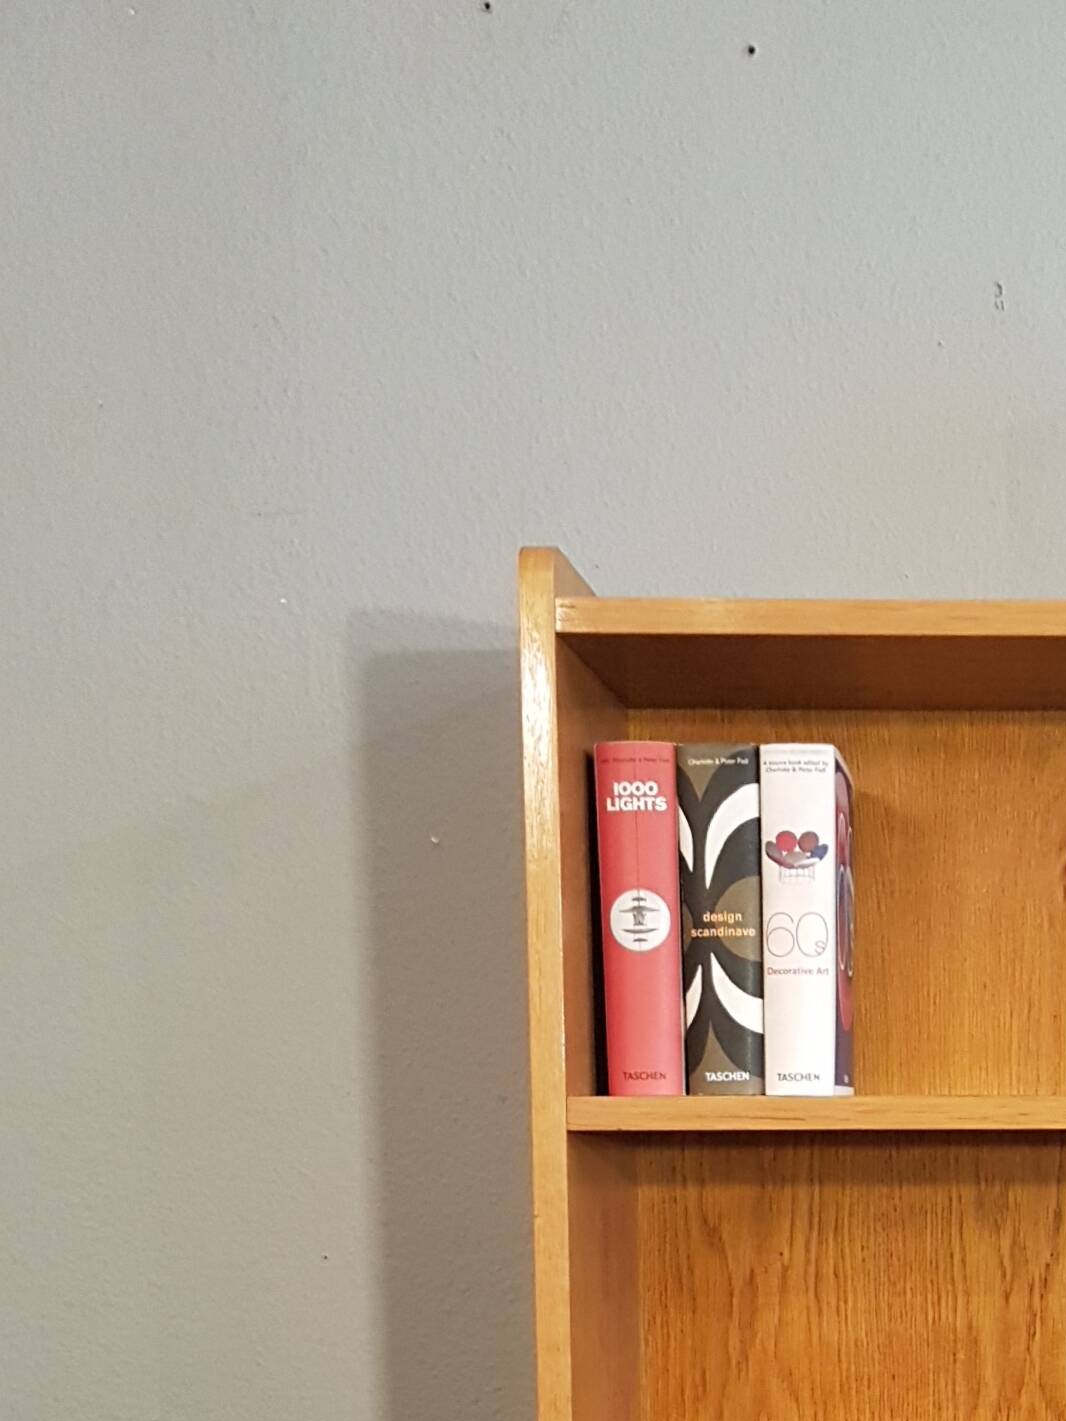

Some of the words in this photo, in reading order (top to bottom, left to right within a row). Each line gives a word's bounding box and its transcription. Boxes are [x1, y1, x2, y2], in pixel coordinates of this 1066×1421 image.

[612, 781, 658, 796] 1000
[606, 796, 668, 812] LIGHTS
[703, 912, 742, 924] design
[690, 927, 756, 938] scandinave
[767, 966, 813, 976] Decorative
[816, 966, 830, 976] Art
[624, 1072, 666, 1081] TASCHEN
[704, 1072, 750, 1082] TASCHEN
[778, 1072, 820, 1082] TASCHEN
